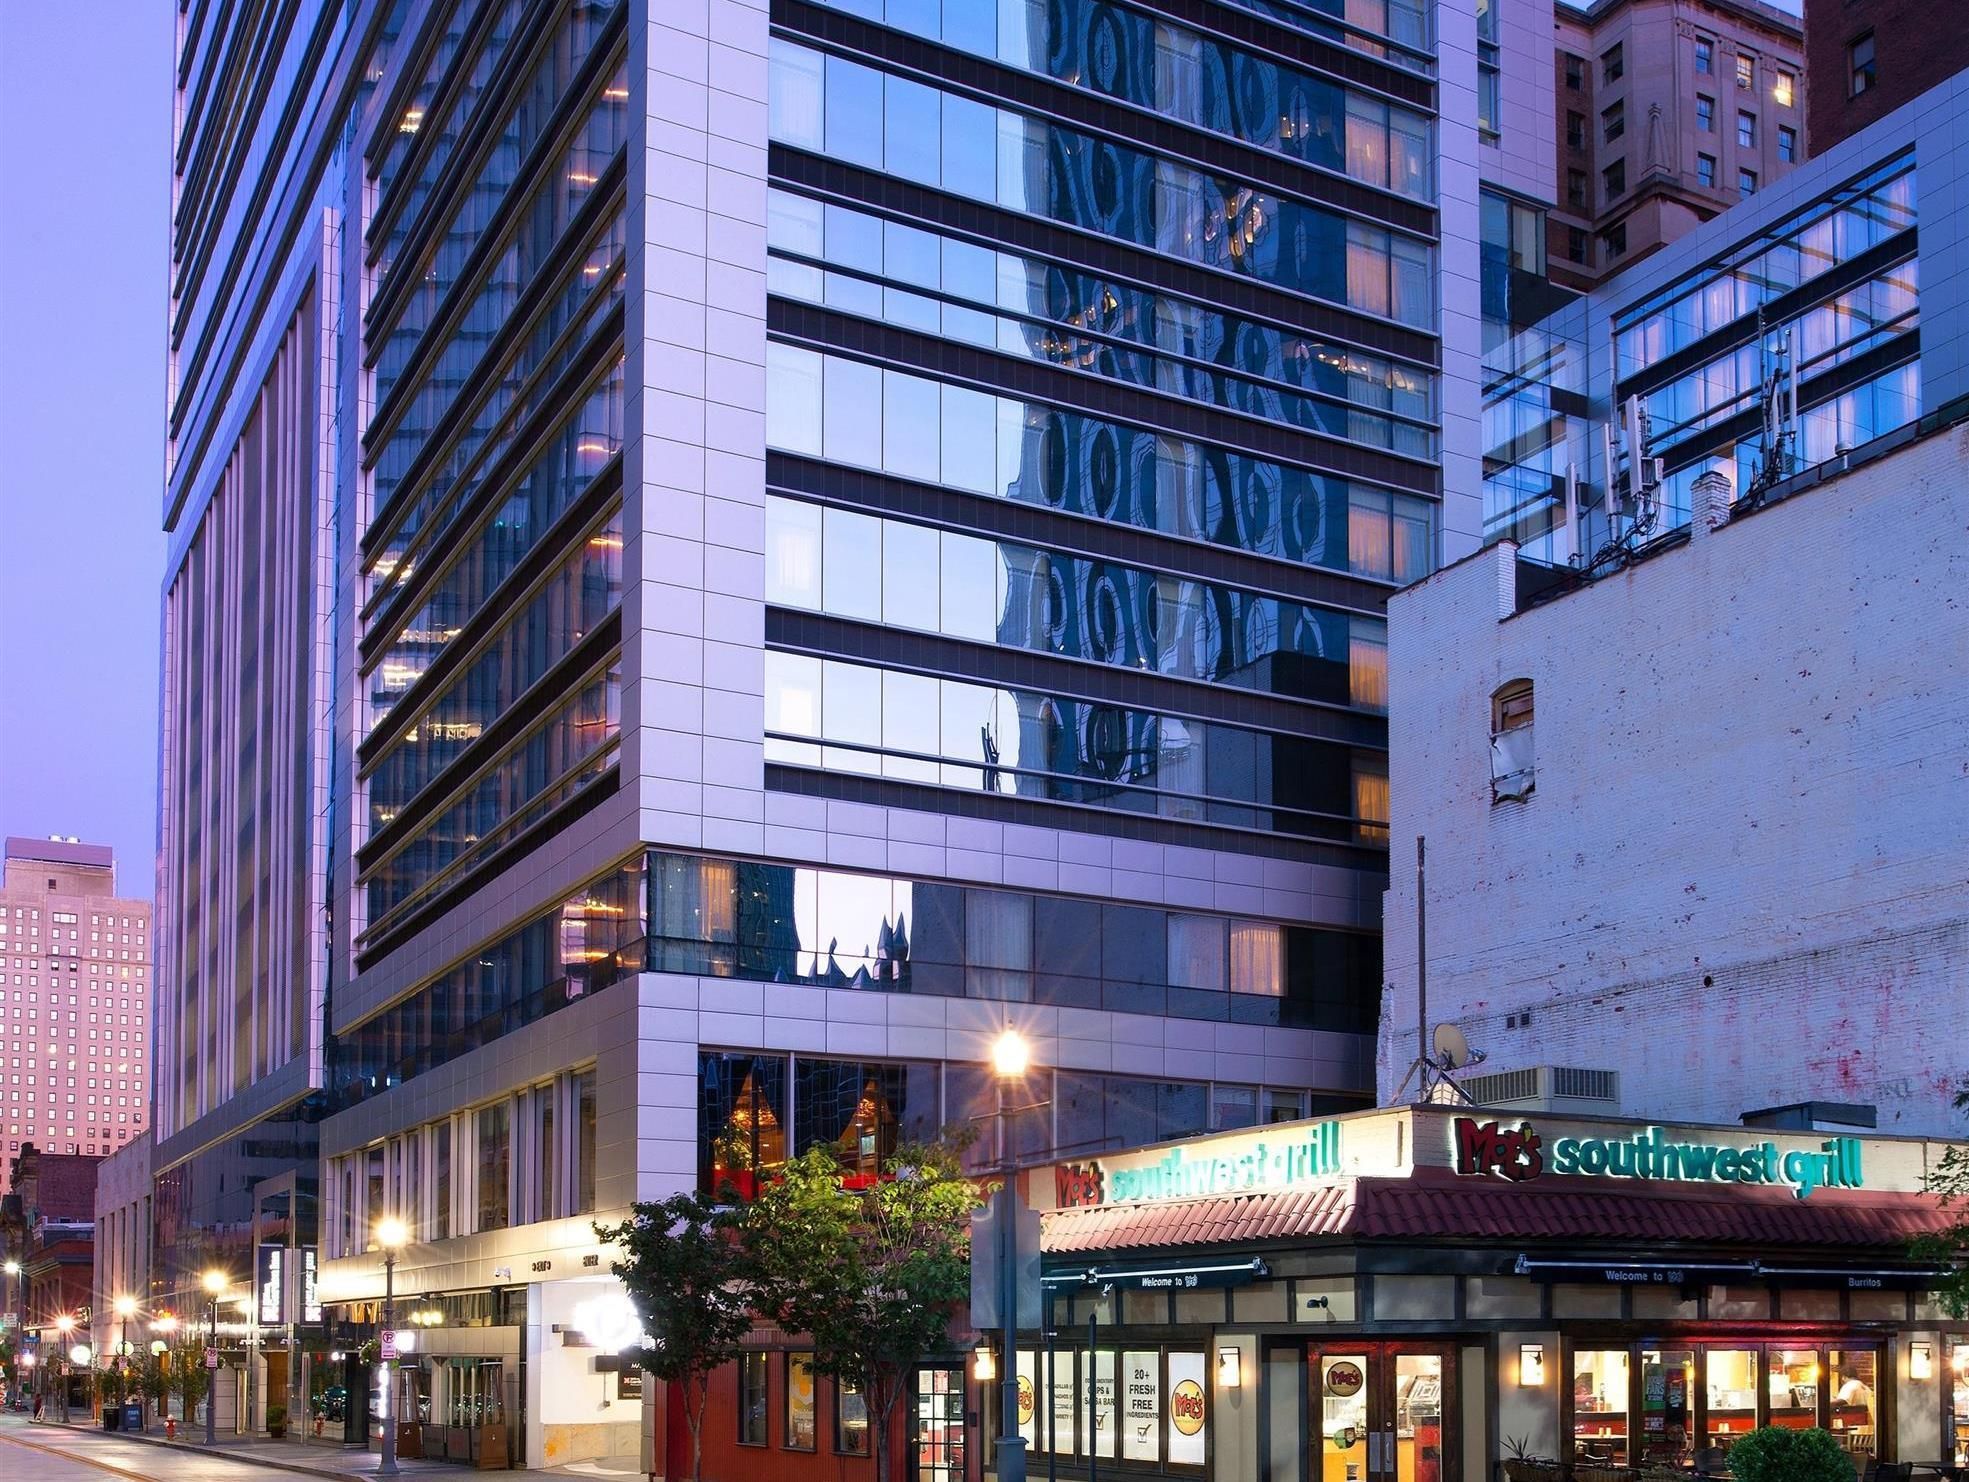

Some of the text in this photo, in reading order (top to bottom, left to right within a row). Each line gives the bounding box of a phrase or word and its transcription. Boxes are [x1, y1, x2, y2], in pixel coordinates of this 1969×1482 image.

[1110, 1147, 1268, 1203] southwest
[1272, 1120, 1342, 1184] grill
[1554, 1126, 1777, 1182] southwest
[1779, 1136, 1862, 1198] grill
[1605, 1270, 1648, 1280] Welcome
[1653, 1272, 1663, 1281] to
[1142, 1277, 1172, 1287] Welcome
[1175, 1277, 1183, 1286] to
[1848, 1277, 1881, 1287] Burritos
[1134, 1369, 1150, 1379] 20+
[1129, 1384, 1156, 1395] FRESH
[1132, 1399, 1153, 1410] FREE
[1126, 1411, 1160, 1420] INGREDIENTS
